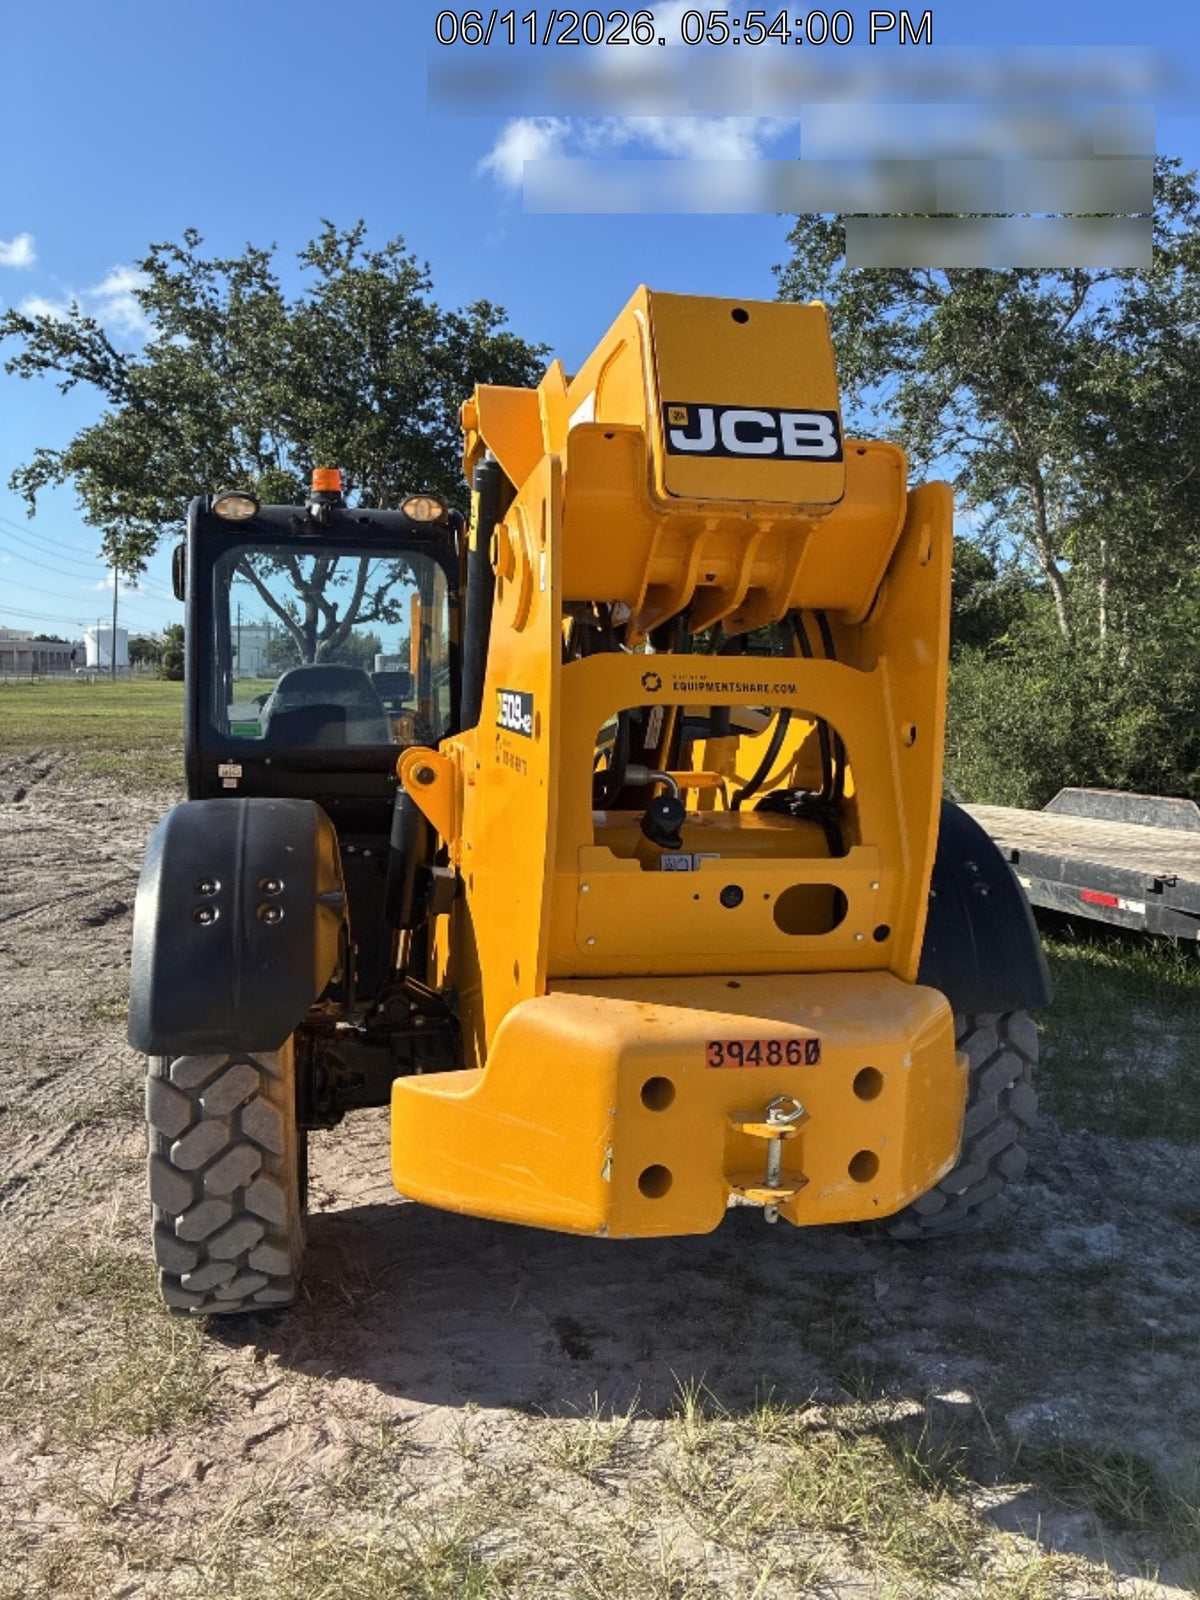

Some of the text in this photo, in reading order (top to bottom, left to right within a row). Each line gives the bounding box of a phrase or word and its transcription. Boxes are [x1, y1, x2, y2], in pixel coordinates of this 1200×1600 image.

[669, 408, 839, 457] JCB
[673, 682, 797, 694] EQUIPMENTSHARE.COM
[708, 1038, 820, 1067] 394860
